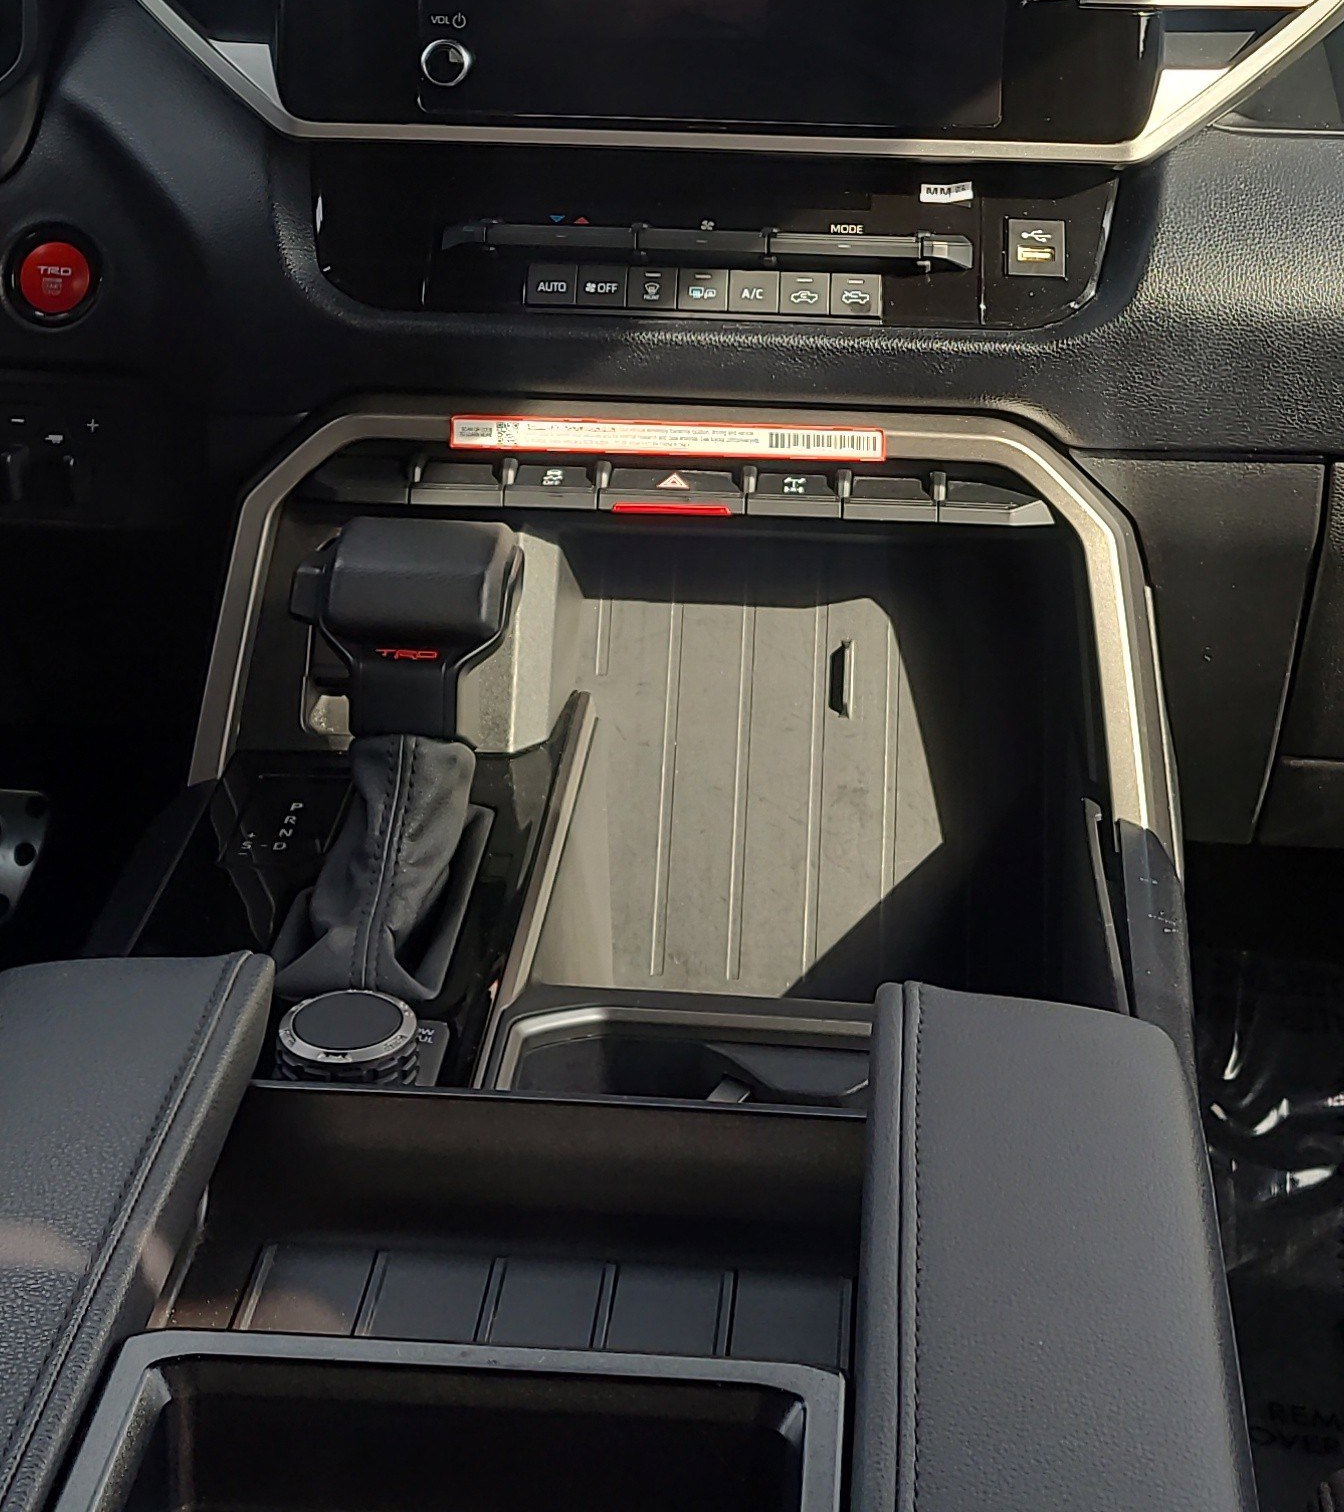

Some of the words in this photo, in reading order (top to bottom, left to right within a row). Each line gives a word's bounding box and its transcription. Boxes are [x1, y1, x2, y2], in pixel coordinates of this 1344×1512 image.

[431, 15, 451, 25] VOL
[830, 224, 863, 235] MODE
[37, 265, 72, 277] TRD
[537, 281, 567, 293] AUTO
[597, 282, 618, 294] OFF
[741, 287, 764, 300] A/C
[375, 648, 437, 660] TRD
[290, 802, 303, 811] P
[284, 815, 296, 824] R
[279, 828, 293, 837] N
[241, 841, 253, 849] S
[272, 842, 287, 850] D
